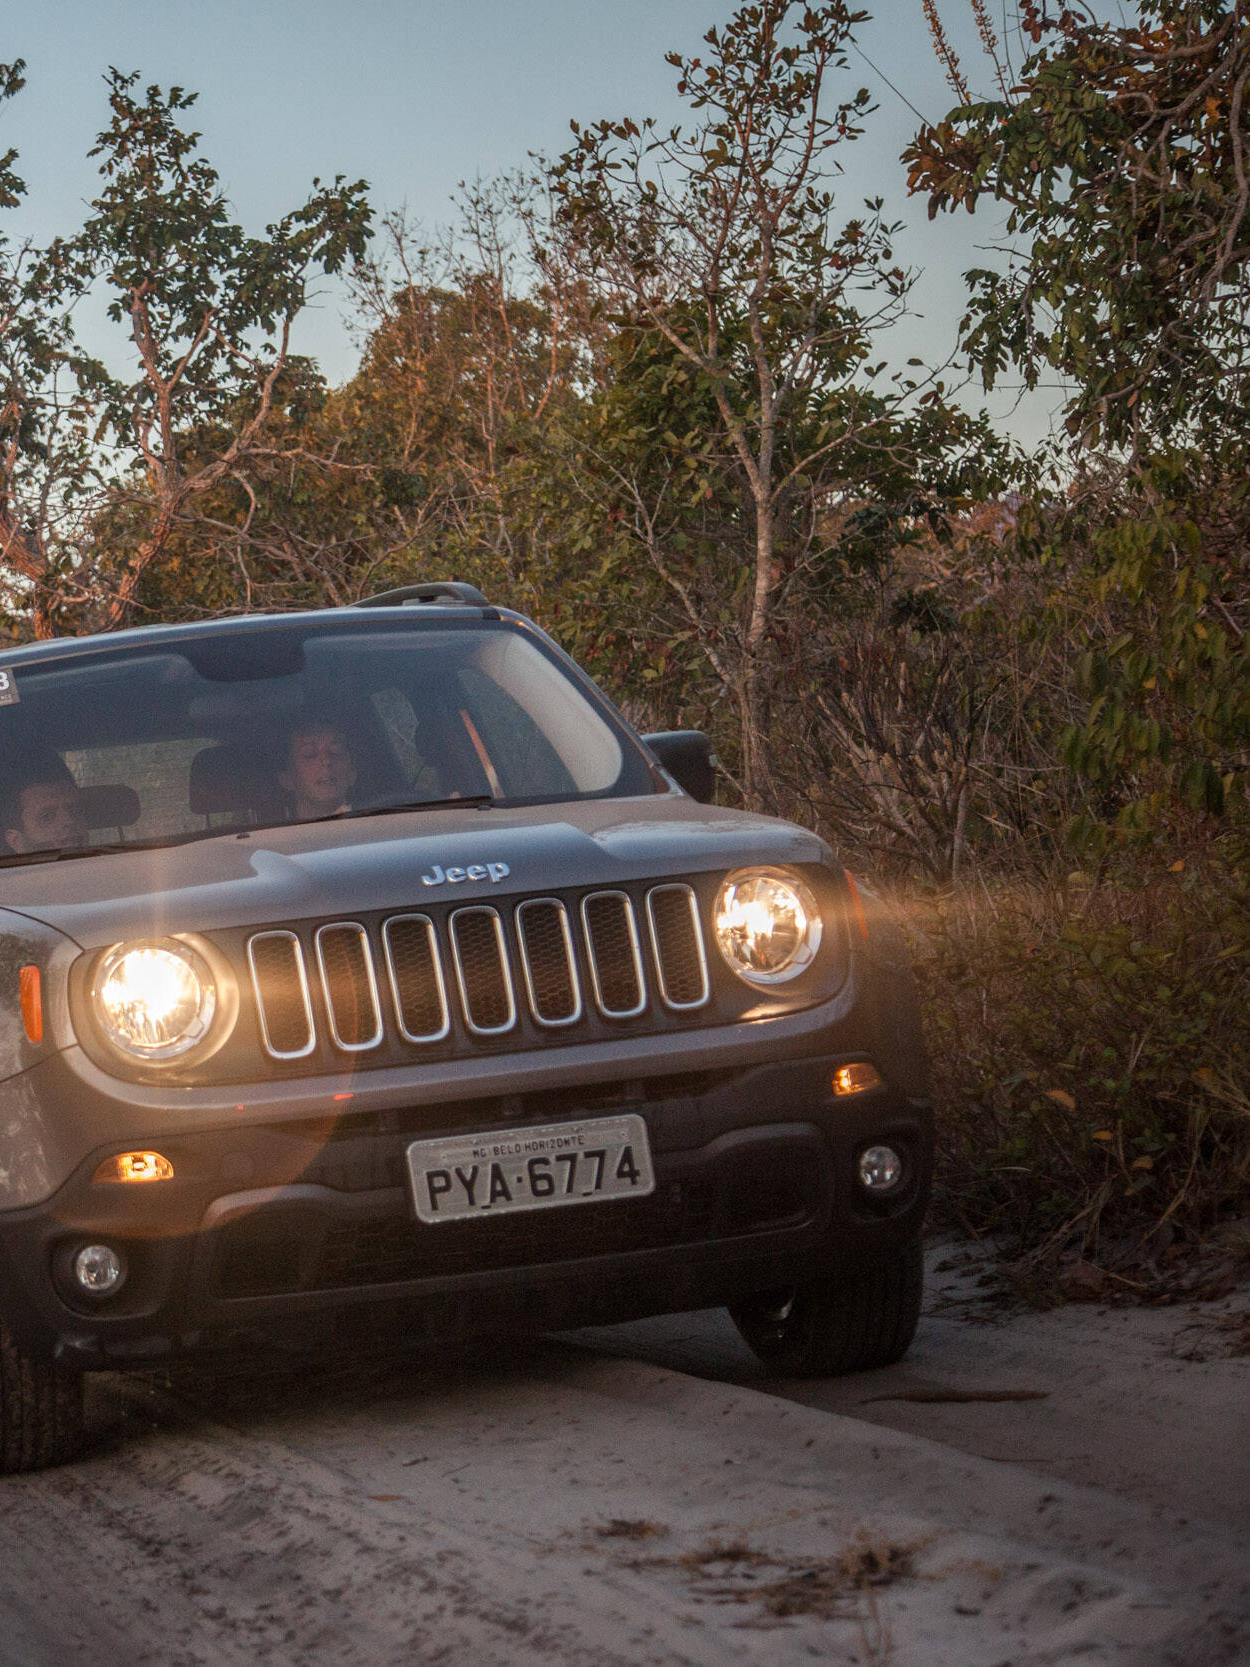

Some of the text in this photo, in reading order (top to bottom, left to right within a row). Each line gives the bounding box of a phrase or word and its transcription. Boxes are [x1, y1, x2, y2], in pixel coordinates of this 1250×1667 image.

[421, 861, 511, 887] Jeep
[493, 1143, 522, 1155] BELO
[524, 1135, 585, 1151] HORIZONTE
